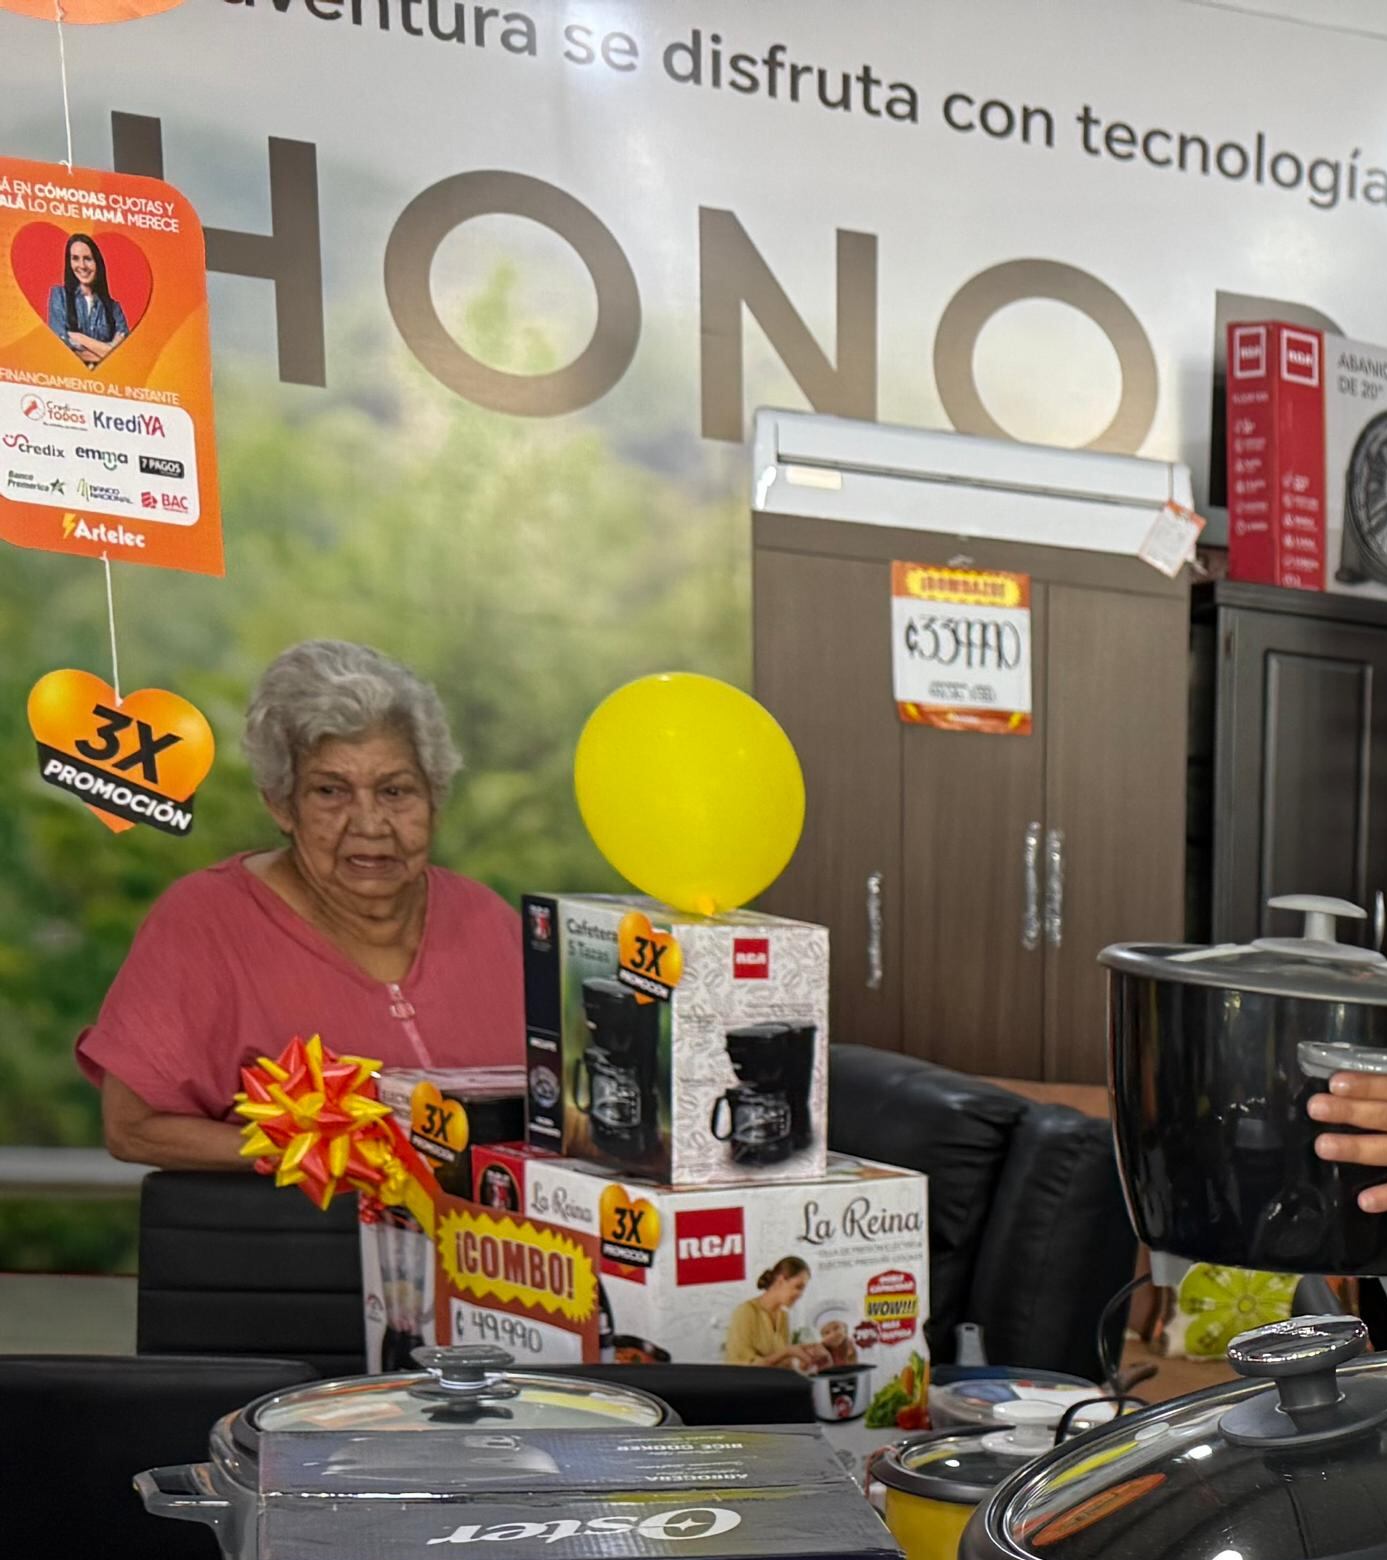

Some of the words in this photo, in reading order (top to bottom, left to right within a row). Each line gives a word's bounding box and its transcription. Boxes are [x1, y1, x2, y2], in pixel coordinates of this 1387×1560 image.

[222, 0, 538, 57] entura
[564, 25, 641, 73] se
[662, 29, 921, 124] disfruta
[942, 92, 1056, 149] con
[28, 197, 48, 214] LO
[49, 200, 81, 219] QUE
[81, 207, 126, 225] MAMÁ
[127, 213, 181, 234] MERECE
[33, 181, 107, 207] CÓMODAS
[108, 194, 164, 215] CUOTAS
[111, 110, 1346, 507] HONO
[1337, 376, 1359, 396] DE
[92, 410, 166, 439] KrediYA
[18, 442, 66, 459] credix
[75, 445, 129, 466] emma
[161, 493, 190, 511] BAC
[73, 518, 146, 549] Artelec
[74, 703, 185, 786] 3X
[42, 758, 193, 831] PROMOCIÓN
[630, 936, 668, 978] 3X
[734, 951, 768, 966] RCA
[419, 1103, 455, 1144] 3X
[611, 1207, 646, 1244] 3X
[796, 1200, 838, 1246] La
[841, 1195, 924, 1242] Reina
[455, 1229, 576, 1301] ¡COMBO!
[678, 1233, 744, 1261] RCA
[866, 1299, 917, 1317] WOW!!!
[425, 1507, 743, 1547] Oster
